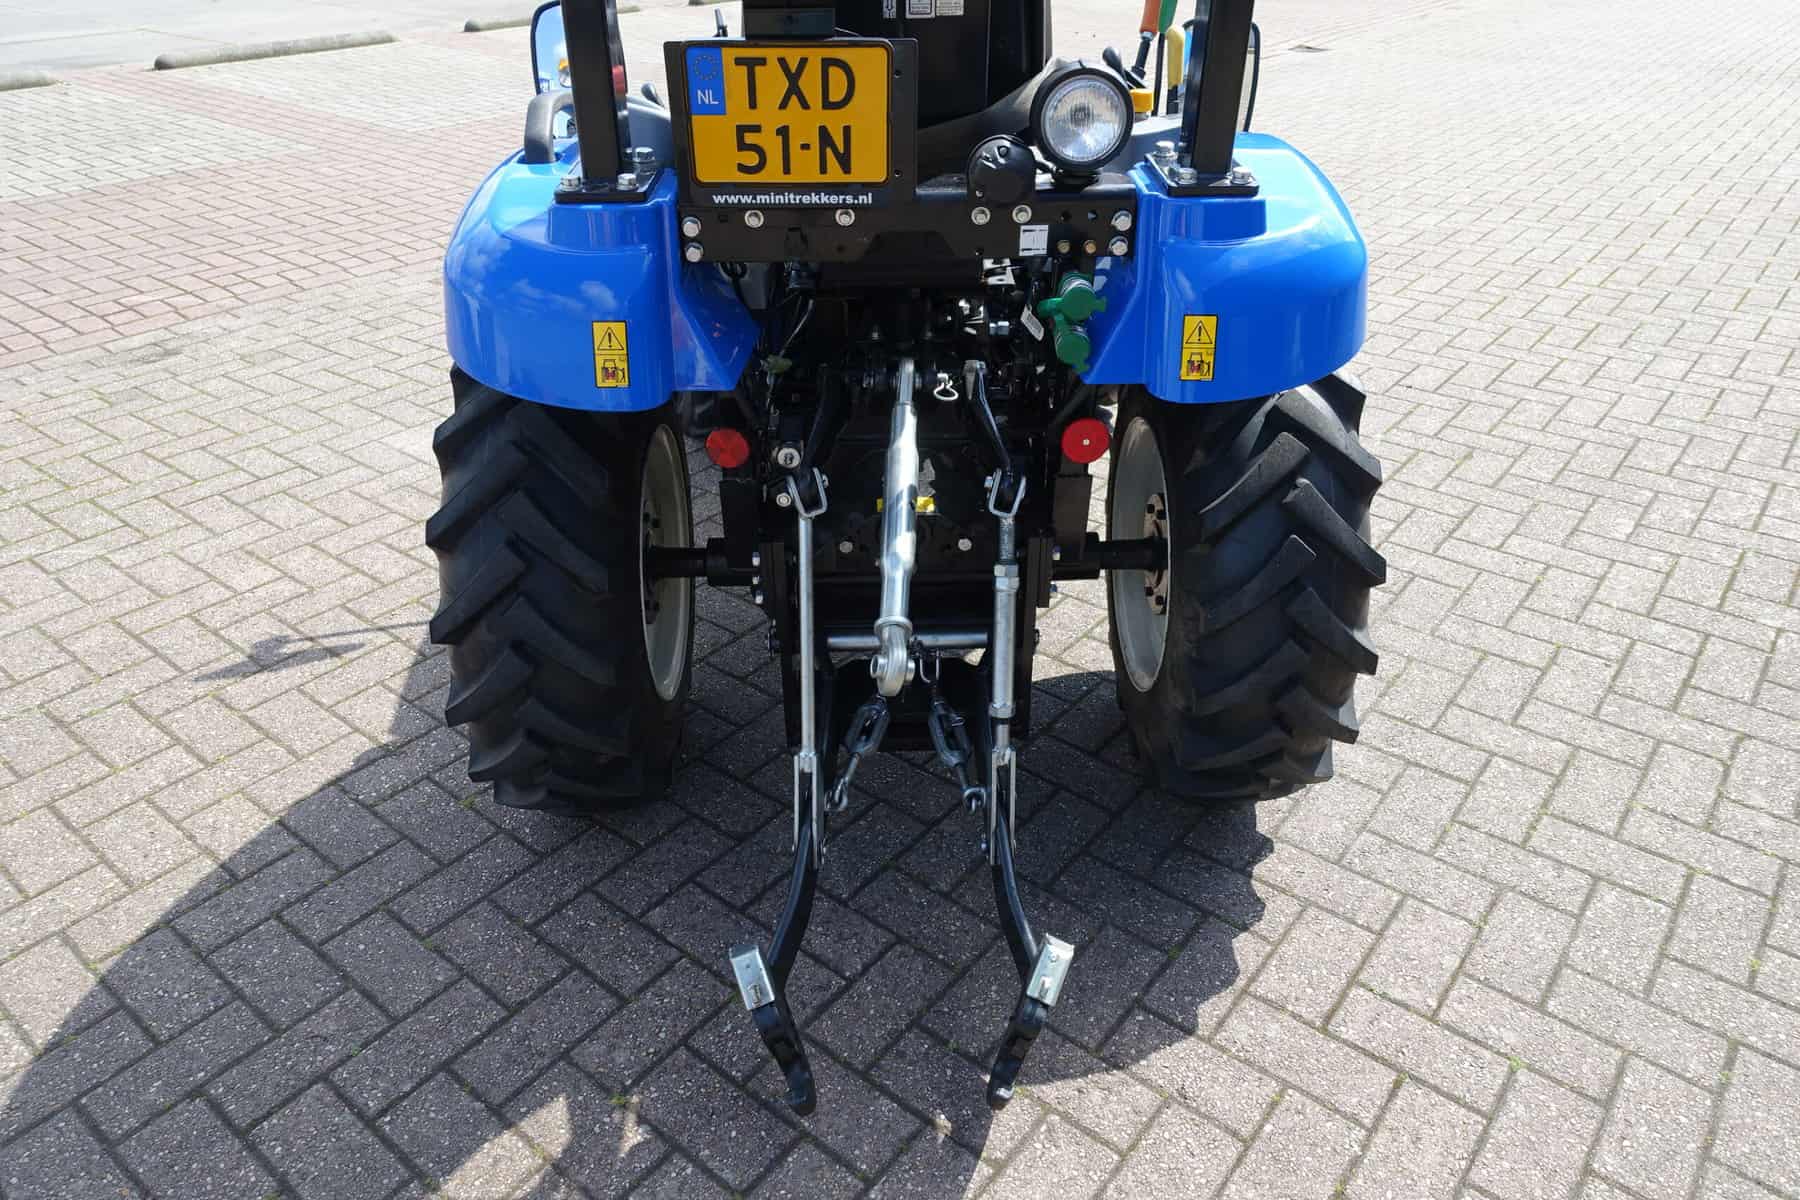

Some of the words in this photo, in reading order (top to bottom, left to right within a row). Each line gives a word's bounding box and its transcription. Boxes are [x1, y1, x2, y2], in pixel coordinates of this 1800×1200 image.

[697, 89, 719, 105] NL
[734, 57, 855, 110] TXD
[734, 124, 852, 175] 51-N
[712, 191, 873, 205] www.minitrekkers.nl
